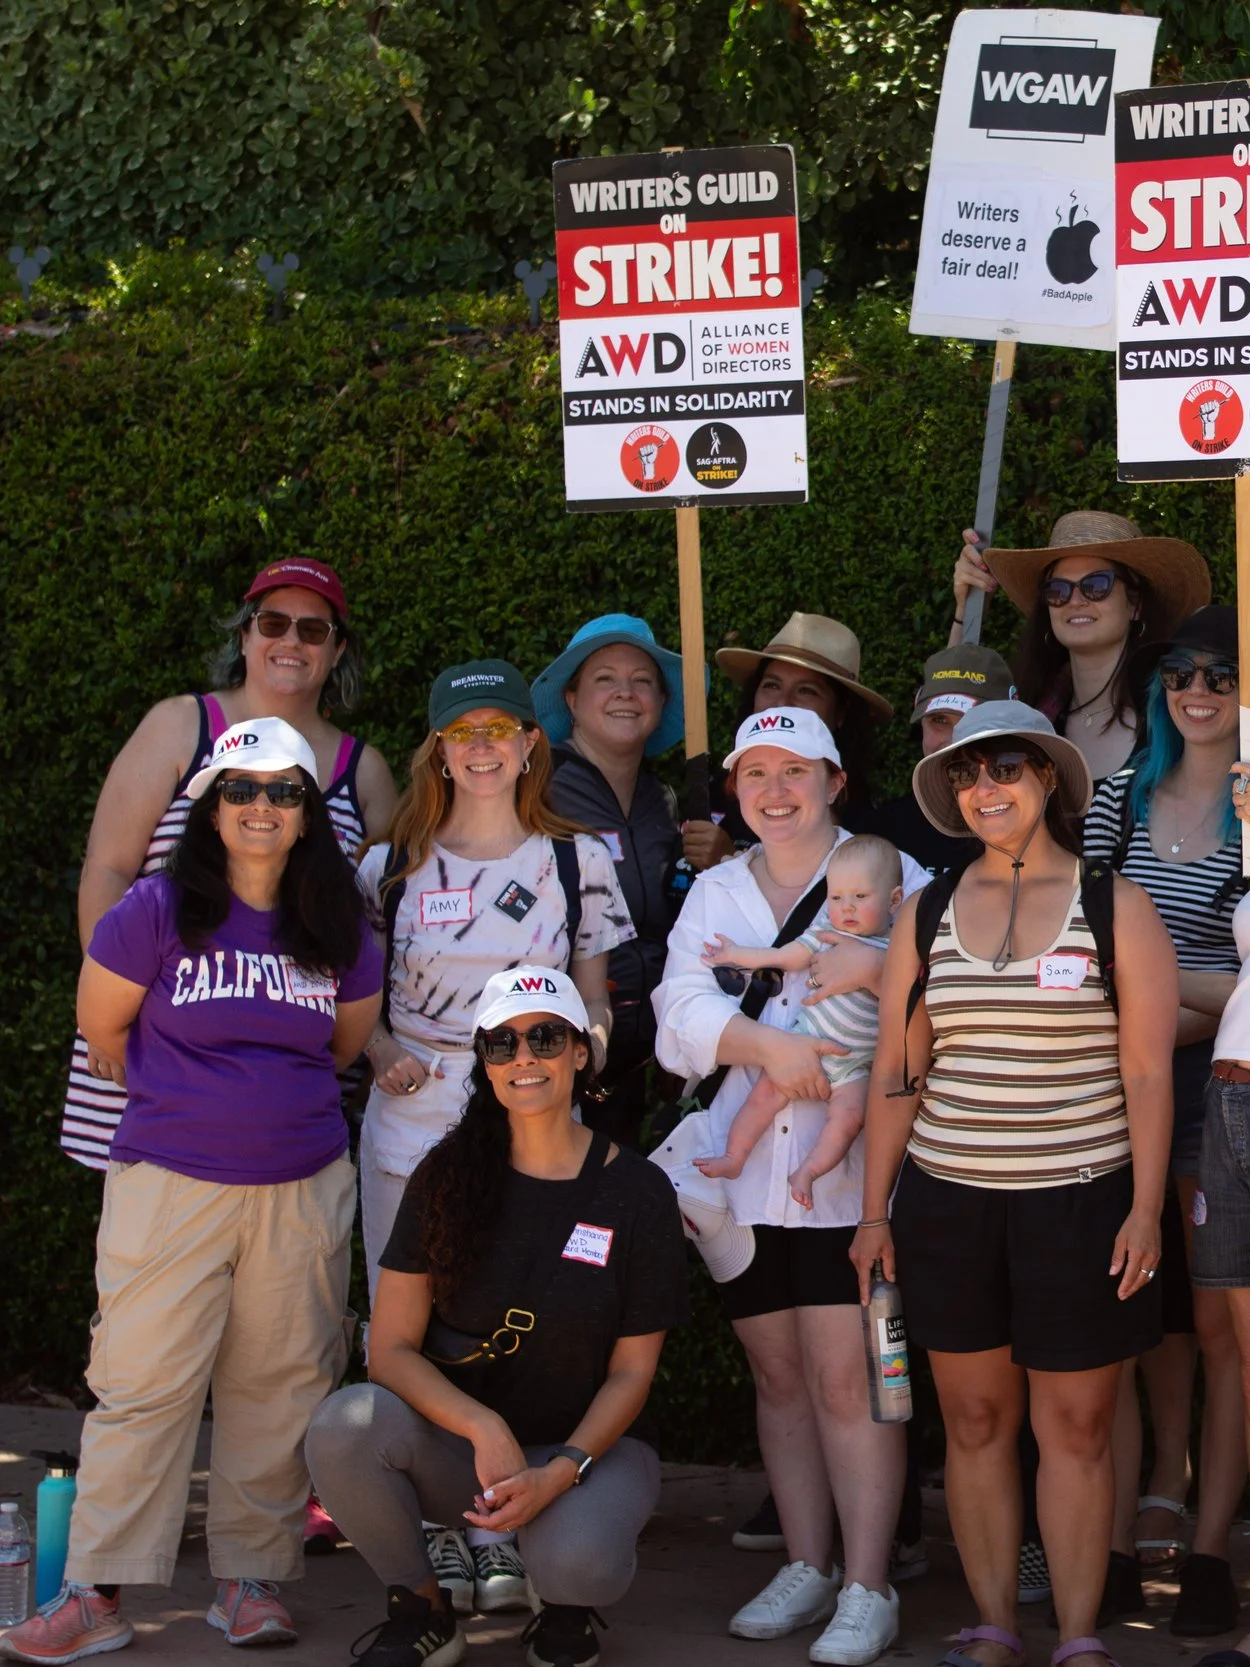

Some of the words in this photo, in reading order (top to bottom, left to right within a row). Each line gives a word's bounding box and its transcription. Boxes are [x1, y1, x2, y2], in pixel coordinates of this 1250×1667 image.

[981, 70, 1108, 106] WGAW
[697, 171, 779, 205] GUILD
[957, 200, 1020, 223] Writers
[660, 214, 686, 234] ON
[941, 229, 1011, 251] deserve
[1016, 239, 1026, 252] a
[574, 233, 783, 307] STRIKE!
[941, 257, 971, 278] fair
[975, 259, 1019, 280] deal!
[1041, 288, 1093, 302] #BadApple
[701, 322, 790, 339] ALLIANCE
[575, 332, 686, 379] AWD
[702, 343, 723, 357] OF
[728, 340, 790, 355] WOMEN
[1125, 348, 1208, 370] STANDS
[1214, 346, 1235, 366] IN
[703, 358, 792, 374] DIRECTORS
[1185, 381, 1213, 403] WRITERS
[1215, 381, 1234, 398] GUILD
[569, 396, 646, 418] STANDS
[650, 395, 670, 413] IN
[675, 389, 794, 412] SOLIDARITY
[625, 426, 651, 446] WRITERS
[1192, 440, 1202, 450] ON
[1204, 438, 1231, 453] STRIKE
[633, 479, 643, 490] ON
[645, 478, 669, 491] STRIKE
[696, 470, 738, 480] STRIKE!
[451, 674, 505, 688] BREAKWATER
[748, 715, 796, 734] AWD
[429, 898, 461, 914] AMY
[1045, 964, 1073, 976] Sam
[510, 977, 558, 994] AWD
